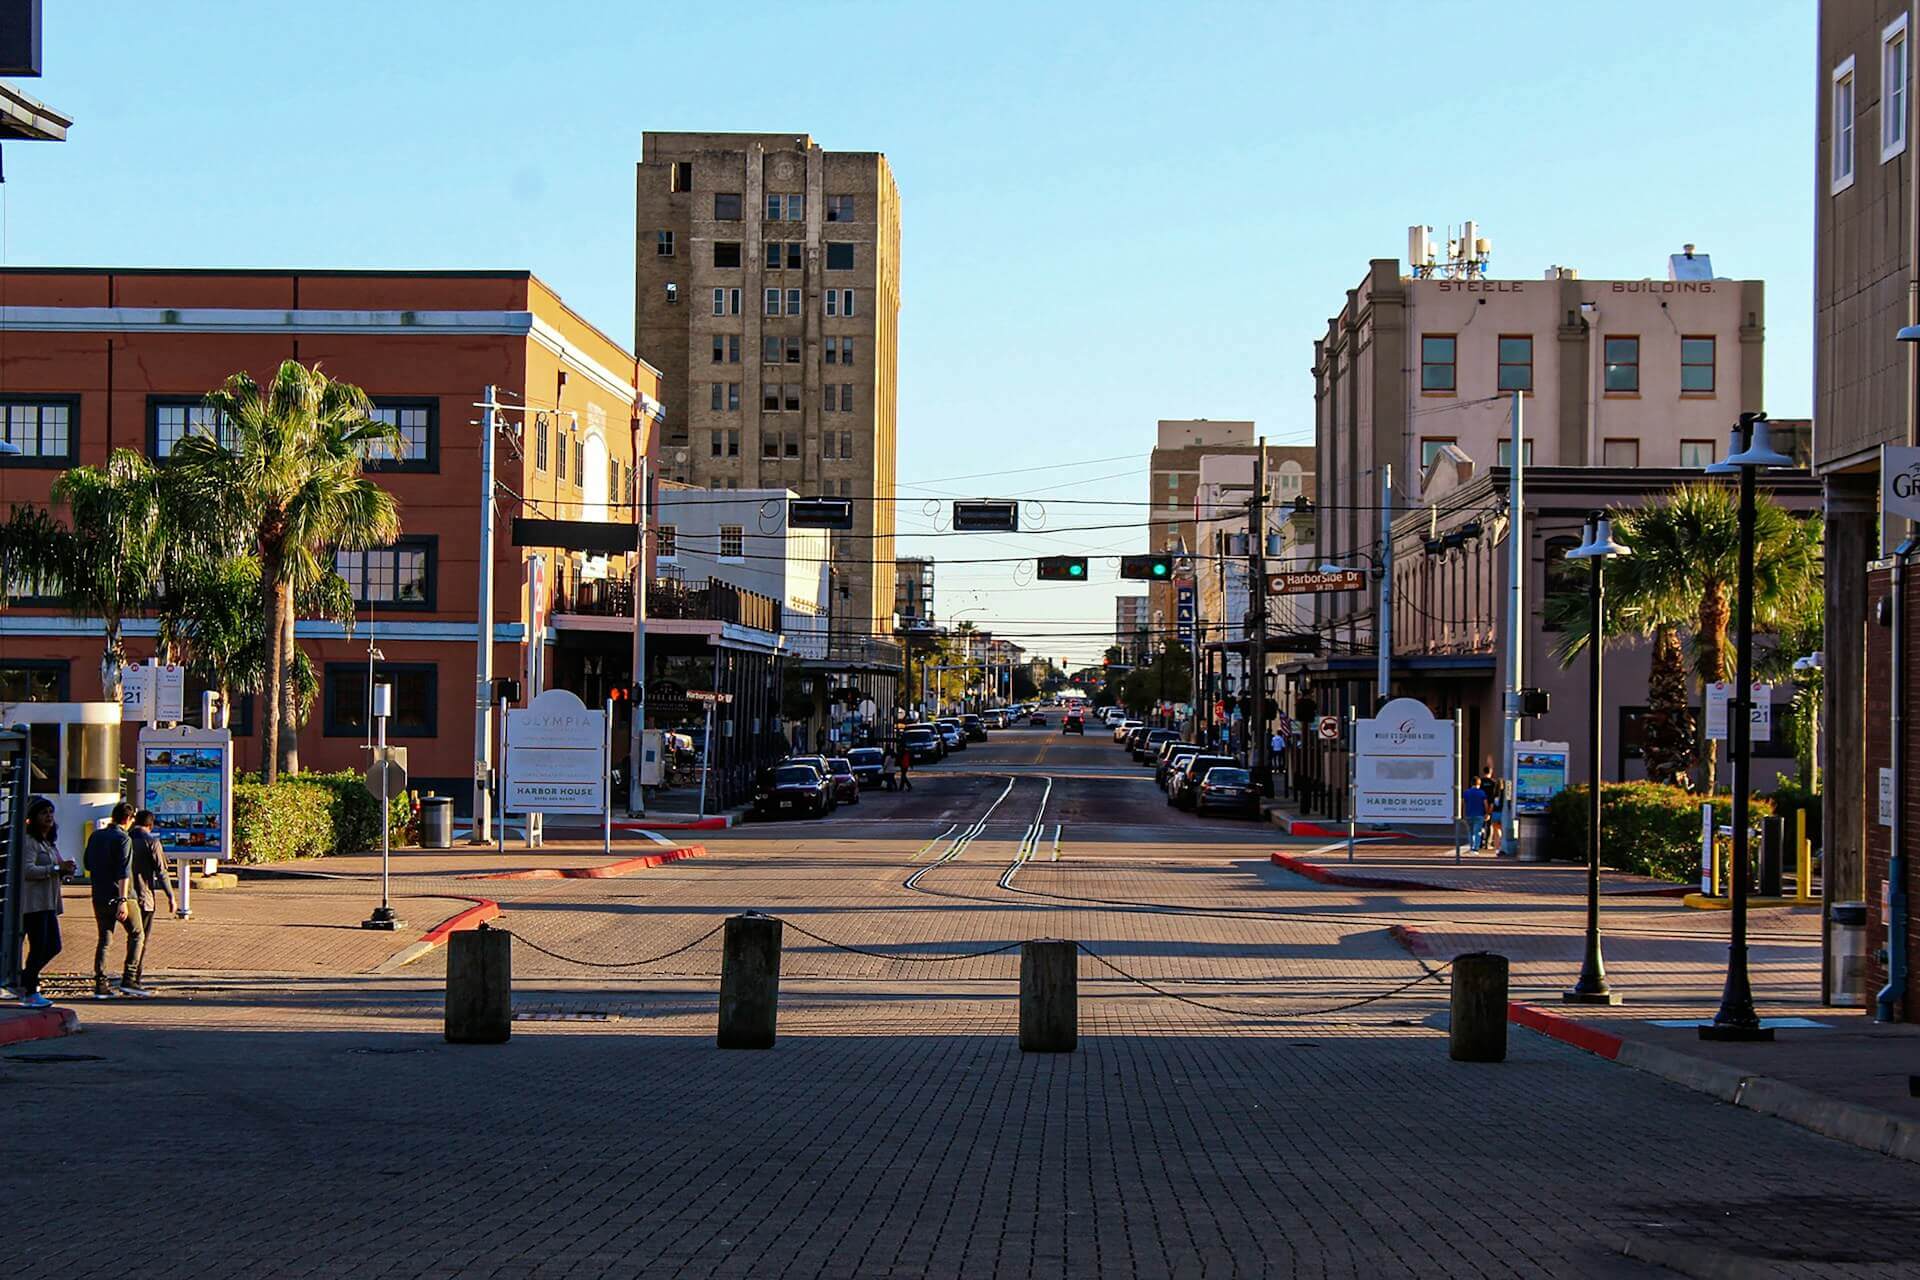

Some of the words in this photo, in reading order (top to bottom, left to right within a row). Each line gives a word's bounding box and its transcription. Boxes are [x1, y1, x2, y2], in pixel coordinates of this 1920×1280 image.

[1439, 281, 1524, 292] STEELE
[1287, 572, 1343, 584] Harborside
[1346, 571, 1359, 581] Dr
[124, 691, 141, 704] 21
[521, 716, 592, 727] OLYMPIA
[1751, 710, 1768, 723] 21
[517, 787, 557, 795] HARBOR
[560, 788, 593, 796] HOUSE
